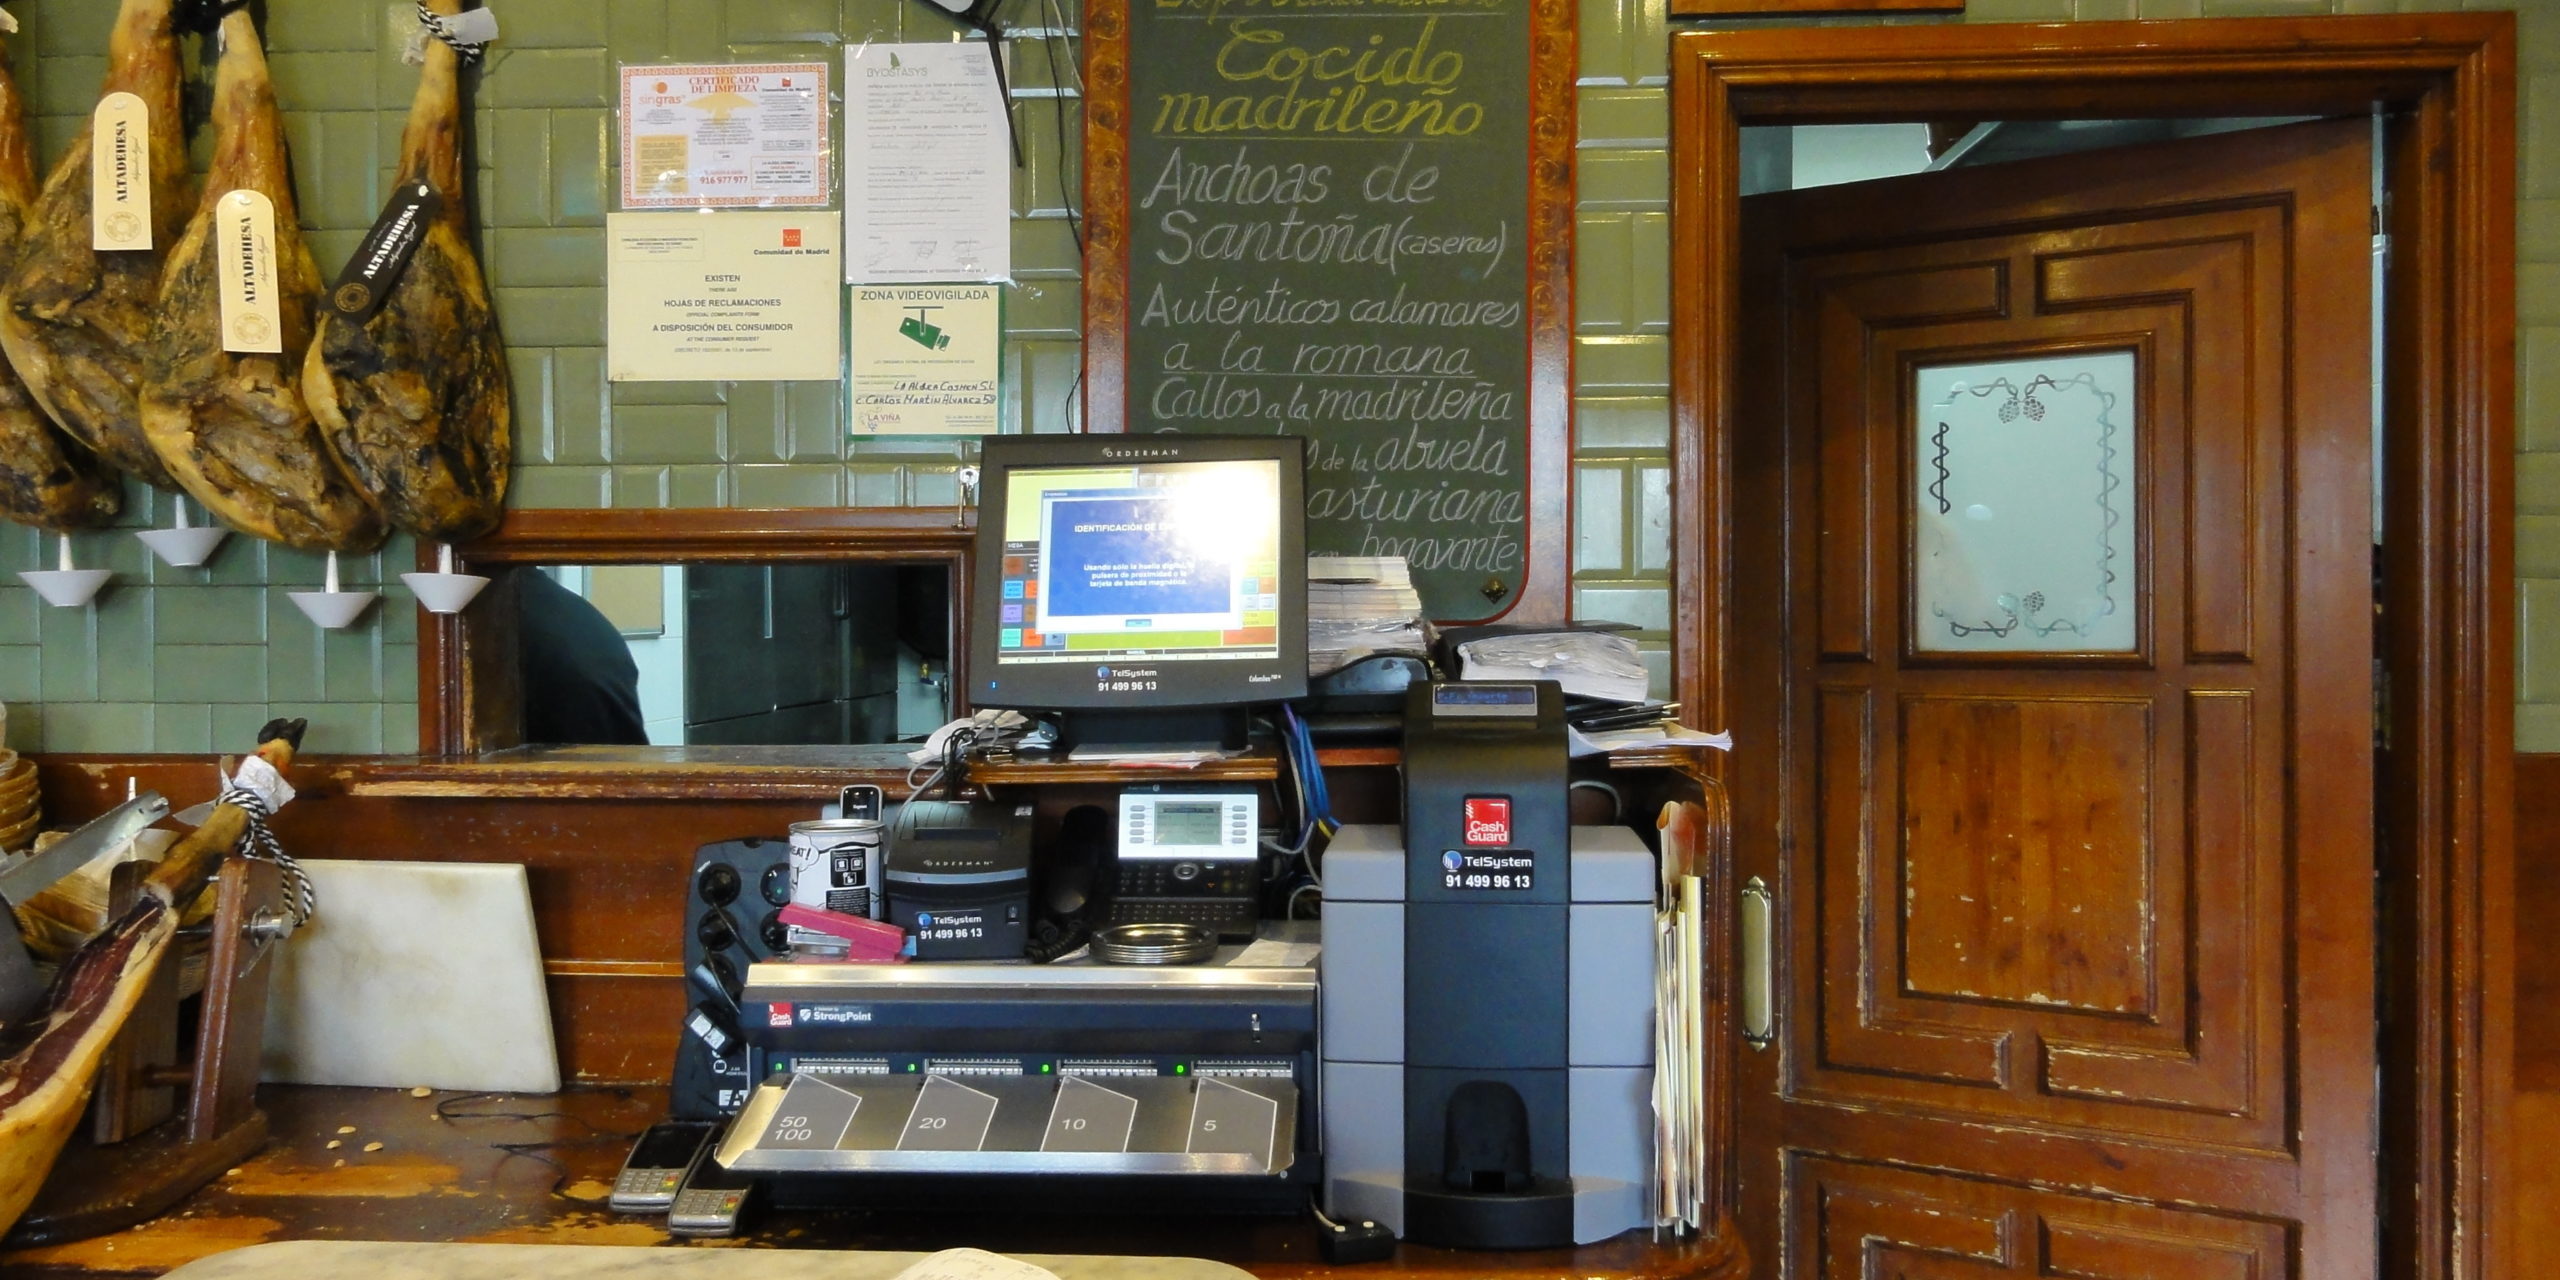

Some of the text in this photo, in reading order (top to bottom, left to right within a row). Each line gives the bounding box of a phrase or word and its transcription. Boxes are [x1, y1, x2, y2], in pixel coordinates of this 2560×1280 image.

[1216, 16, 1464, 86] Cocido
[689, 76, 759, 85] CERTIFICADO
[692, 84, 758, 93] DE LIMPIEZA
[639, 95, 682, 107] singras
[1152, 76, 1483, 136] madrileño
[116, 120, 127, 203] ALTADEHESA
[1141, 142, 1440, 209] Anchoas de
[363, 203, 420, 280] ALTADEHESA
[240, 216, 256, 305] ALTADEHESA
[704, 274, 741, 282] EXISTEN
[860, 290, 990, 301] ZONA VIDEOVIGILADA
[1141, 278, 1520, 327] Auténticos calamares
[660, 323, 714, 332] DISPOSICIÓN
[1164, 331, 1474, 375] a la romana
[1152, 374, 1513, 422] Callos a la madrileña
[1106, 449, 1178, 458] ORDERMAN
[1321, 443, 1344, 471] de
[1351, 444, 1369, 472] la
[1374, 423, 1509, 476] abuela
[1307, 475, 1524, 525] asturiana
[1074, 523, 1142, 533] IDENTIFICACIÓN
[1112, 668, 1157, 678] TelSystem
[1098, 681, 1156, 692] 91 499 96 13
[1470, 820, 1505, 832] Cash
[1466, 830, 1508, 842] Guard
[1464, 856, 1532, 869] TelSystem
[1446, 874, 1530, 888] 91 499 96 13
[933, 916, 982, 925] TelSystem
[920, 928, 982, 940] 91 499 96 13
[770, 1018, 792, 1026] Guard
[814, 1012, 872, 1022] StrongPoint
[780, 1116, 1217, 1132] 50 20 10 5
[774, 1129, 812, 1141] 100
